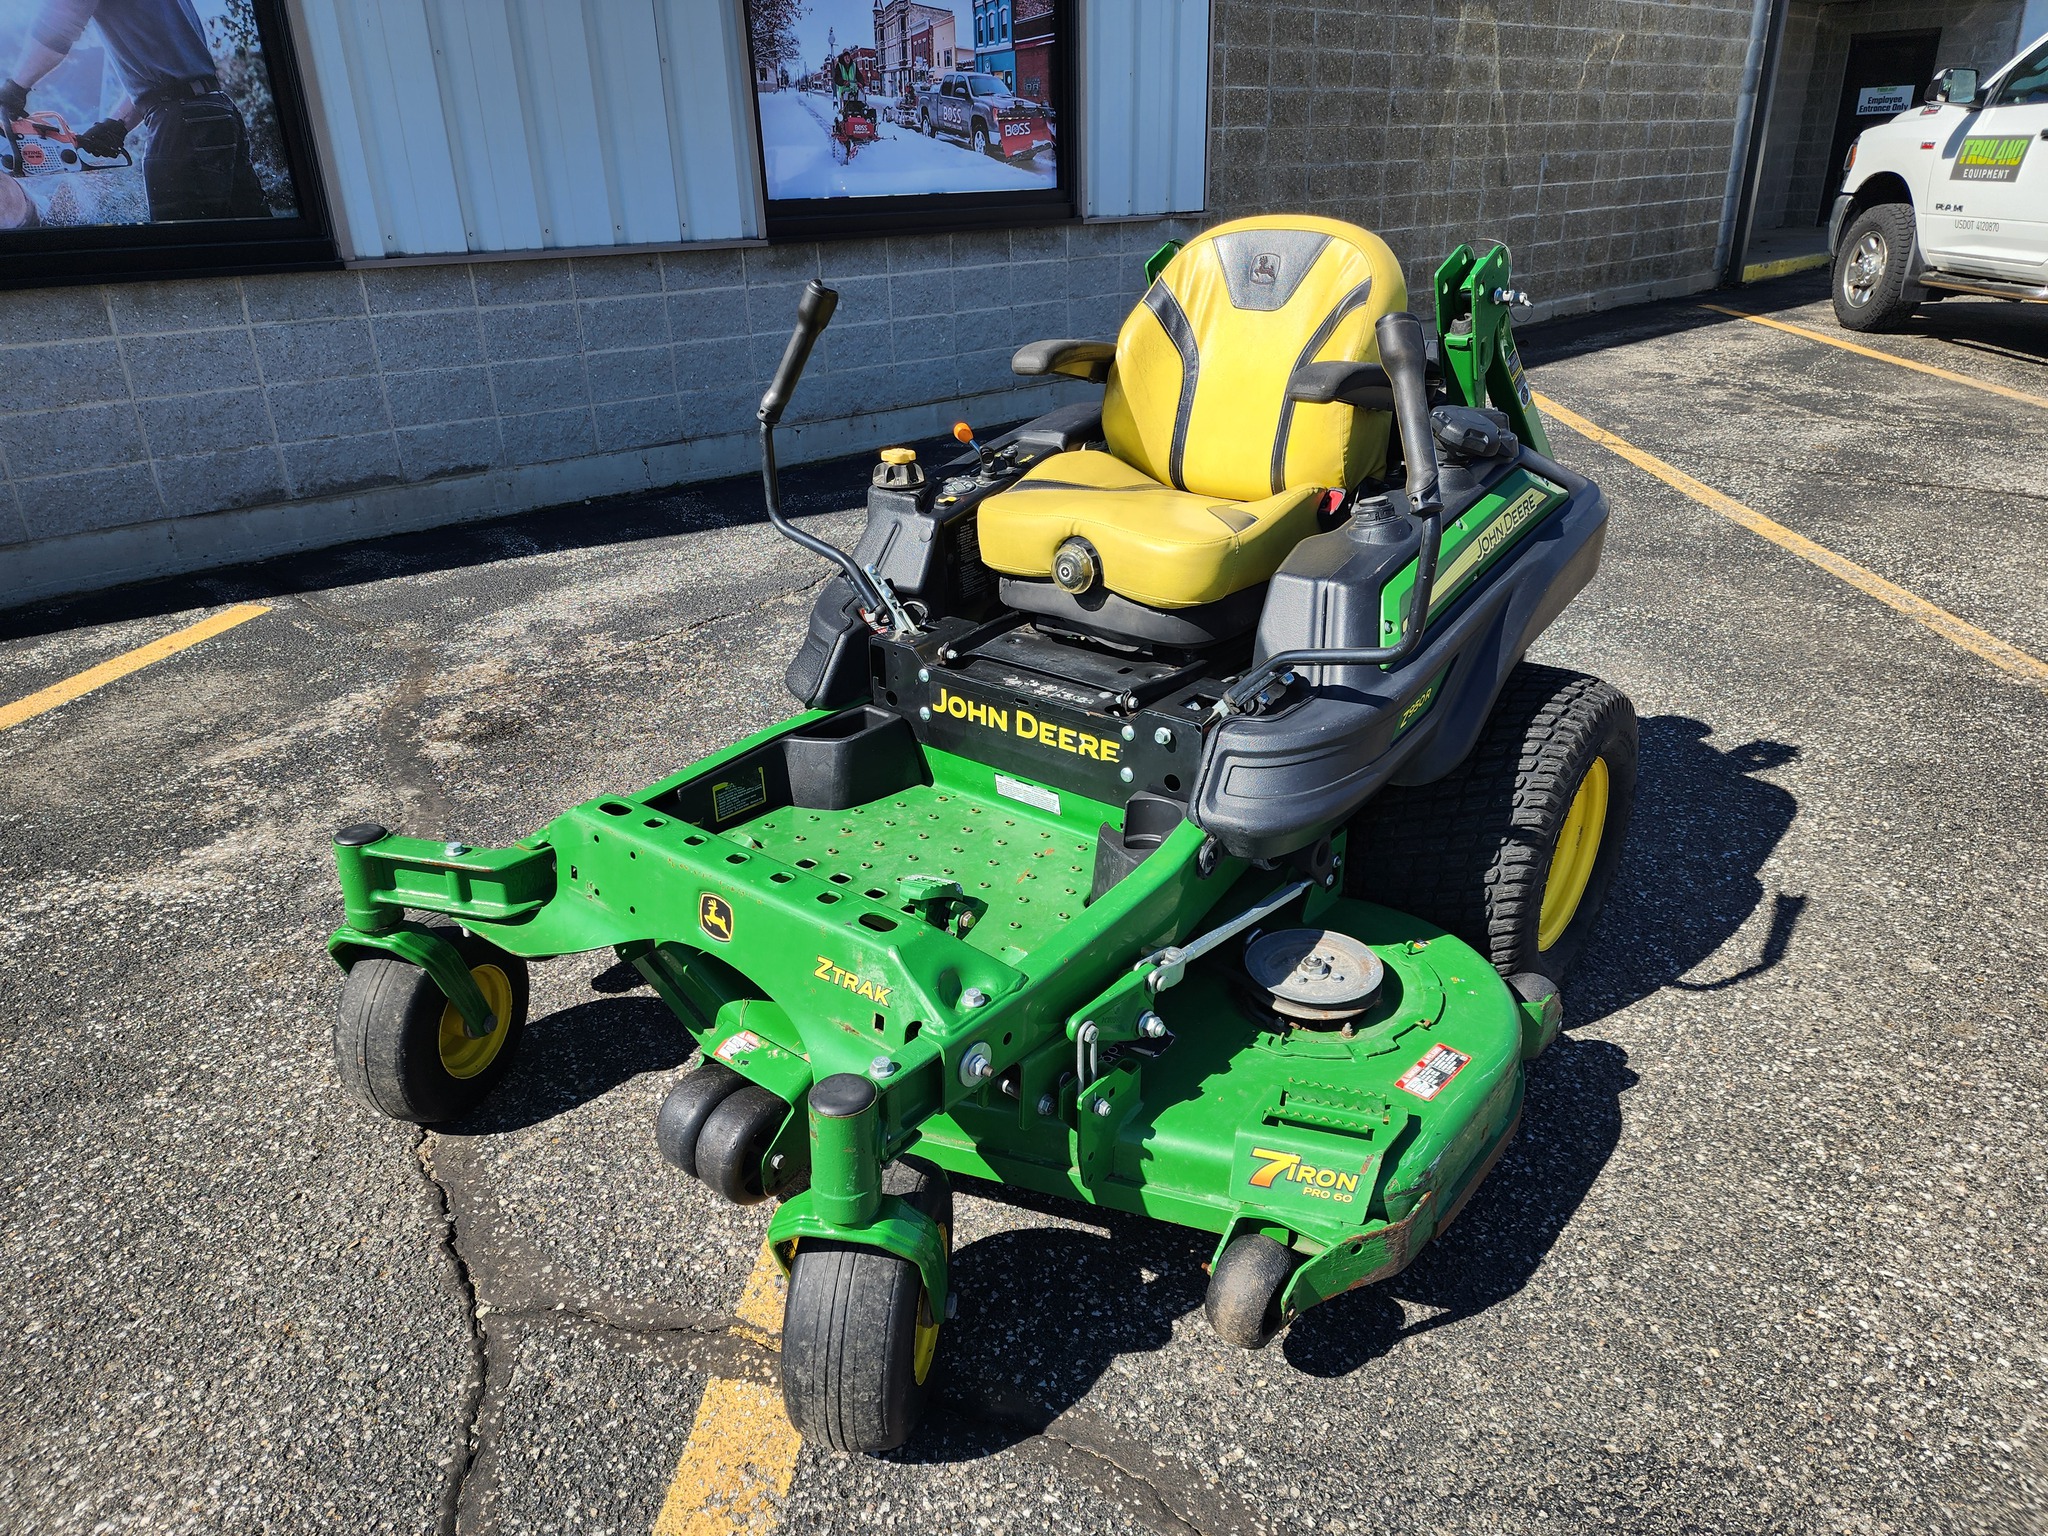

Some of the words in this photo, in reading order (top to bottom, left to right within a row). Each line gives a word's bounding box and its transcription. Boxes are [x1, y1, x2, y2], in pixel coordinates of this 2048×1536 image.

[1859, 104, 1891, 113] Entrance
[1891, 103, 1909, 111] Only
[1867, 96, 1903, 105] Employee
[943, 106, 962, 124] BOSS
[1004, 122, 1031, 137] BOSS
[1959, 139, 2028, 166] TRULAND
[1963, 168, 2010, 179] EQUIPMENT
[1935, 203, 1964, 212] RAM
[1954, 219, 1975, 230] USDOT
[1975, 221, 2000, 232] 4120870
[1477, 522, 1505, 562] JOHN
[1503, 494, 1538, 535] DEERE
[932, 688, 1008, 732] JOHN
[1015, 709, 1121, 764] DEERE
[813, 955, 894, 1008] ZTRAK
[1302, 1187, 1331, 1200] PRO
[1333, 1193, 1354, 1203] 60
